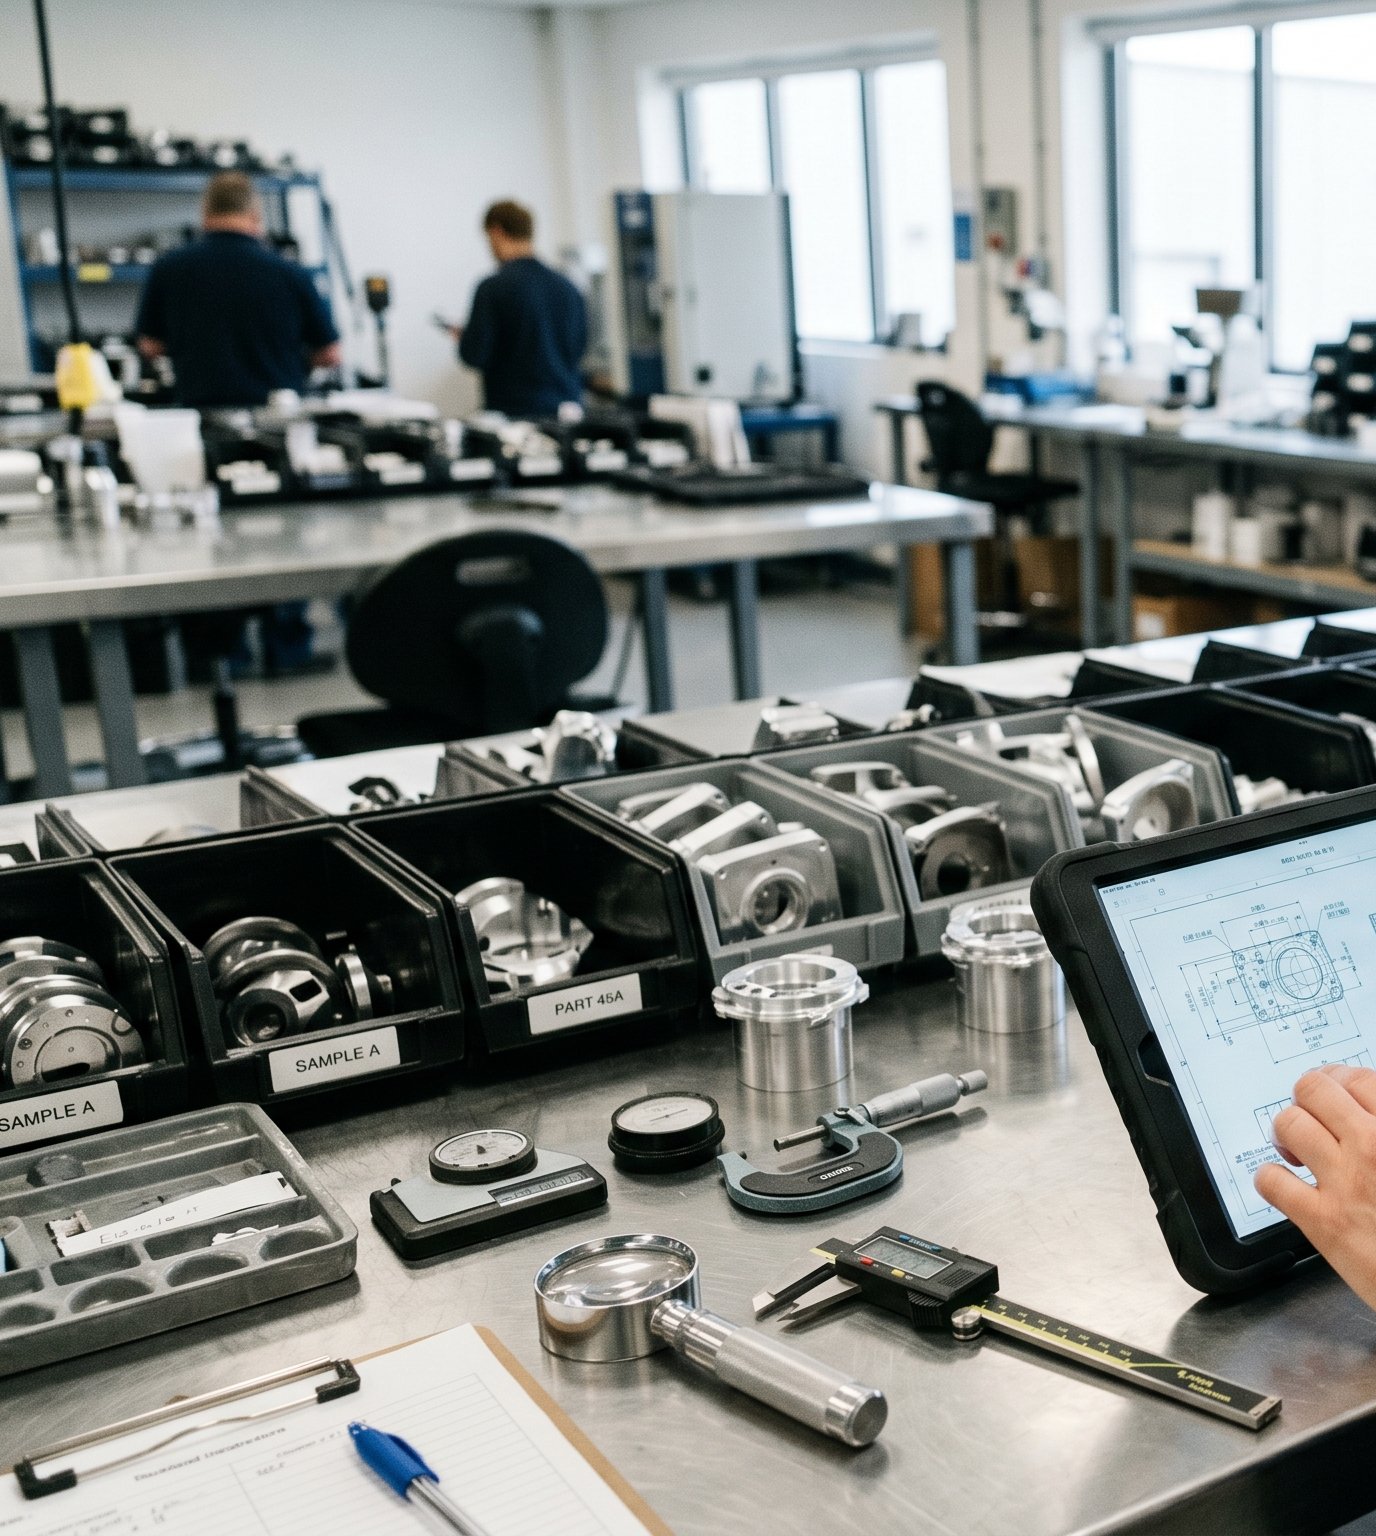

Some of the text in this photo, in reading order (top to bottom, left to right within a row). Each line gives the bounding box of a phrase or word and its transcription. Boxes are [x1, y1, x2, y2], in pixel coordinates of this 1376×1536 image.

[555, 996, 593, 1015] PART
[295, 1044, 381, 1073] SAMPLE A
[0, 1100, 95, 1132] SAMPLE A
